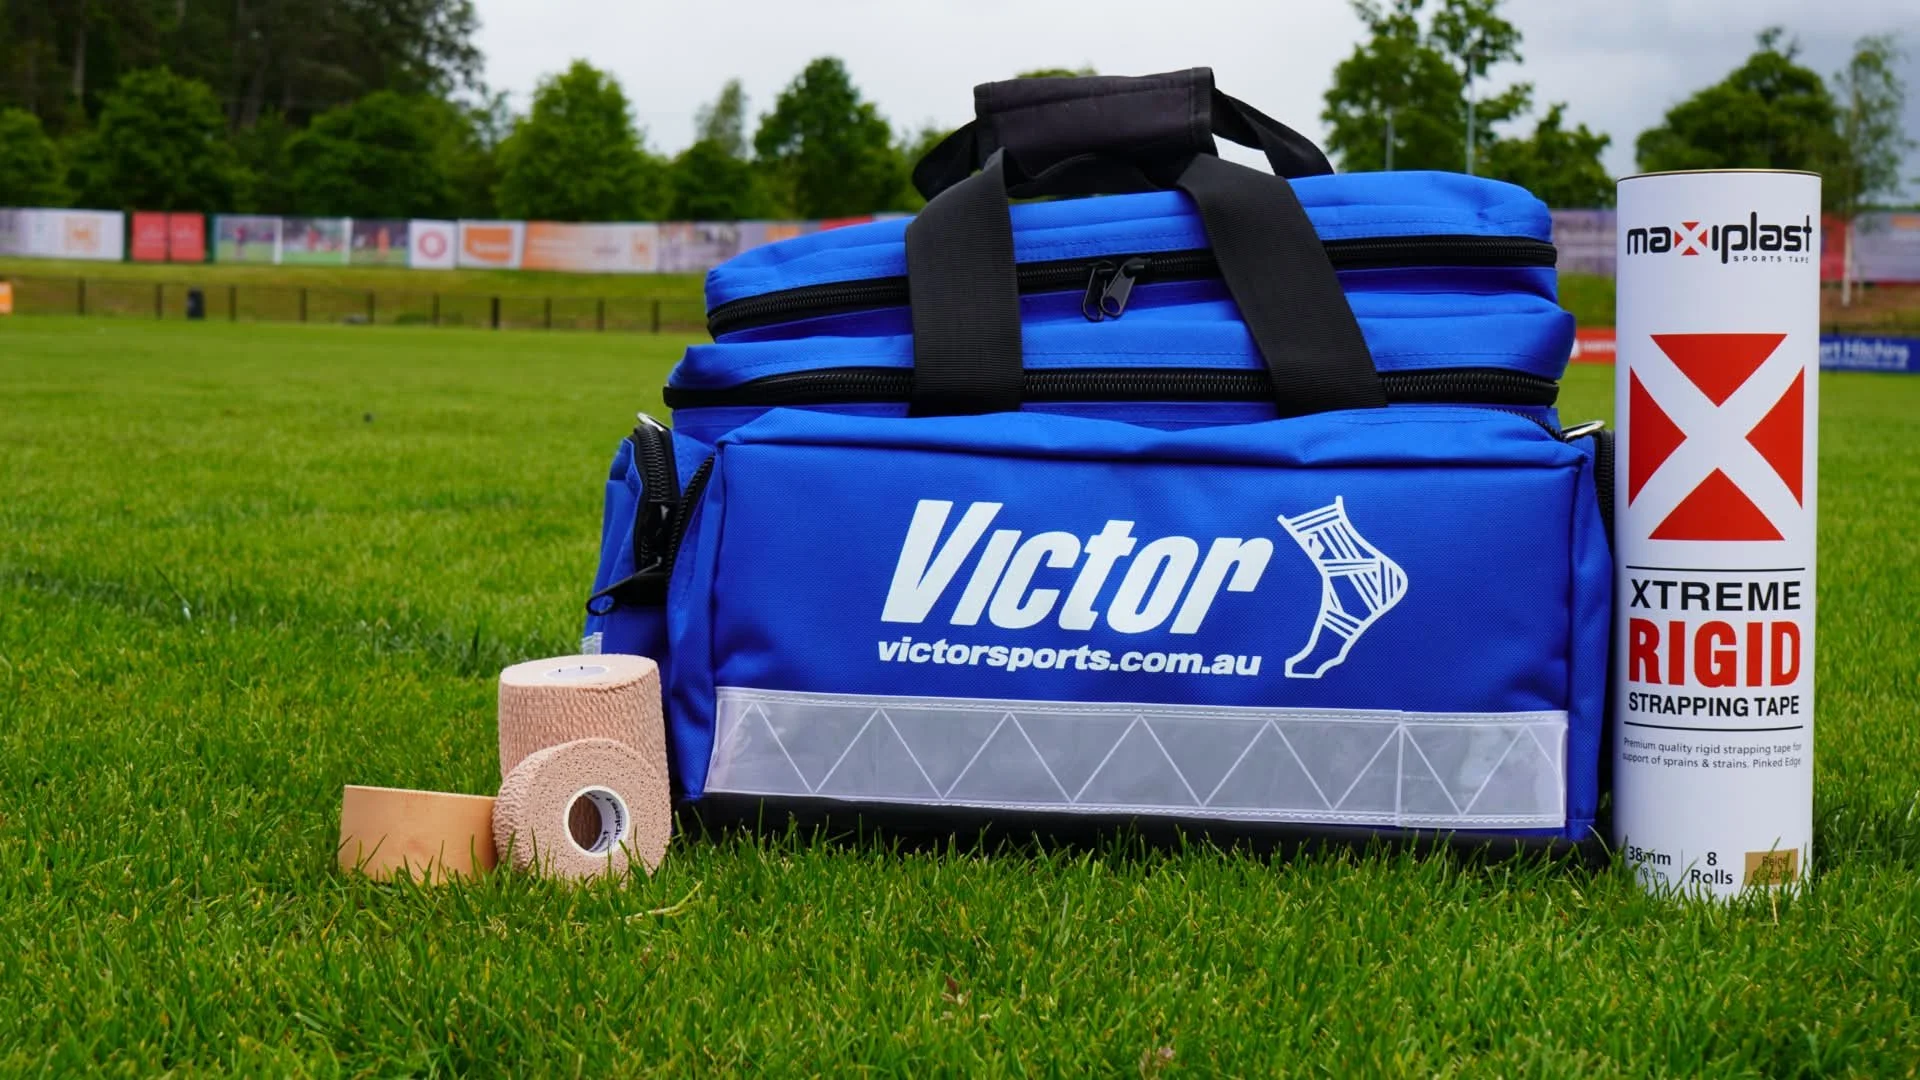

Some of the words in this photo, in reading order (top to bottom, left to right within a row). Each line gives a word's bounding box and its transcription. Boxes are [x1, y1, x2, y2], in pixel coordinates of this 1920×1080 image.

[1733, 255, 1782, 263] SPORTS
[880, 499, 1274, 635] Victor
[1630, 579, 1801, 611] XTREME
[877, 636, 1262, 676] victorsports.com.au
[1629, 617, 1800, 688] RIGID
[1629, 691, 1749, 717] STRAPPING
[1753, 695, 1799, 717] TAPE
[1624, 736, 1656, 750] Premium
[1658, 743, 1692, 754] quality
[1695, 744, 1720, 756] rigid
[1723, 744, 1771, 756] strapping
[1773, 745, 1791, 754] tape
[1651, 755, 1661, 765] of
[1663, 758, 1698, 767] sprains
[1702, 758, 1709, 768] &
[1713, 759, 1749, 768] strains.
[1753, 758, 1783, 768] Pinked
[1707, 851, 1717, 866] 8
[1691, 870, 1733, 885] Rolls
